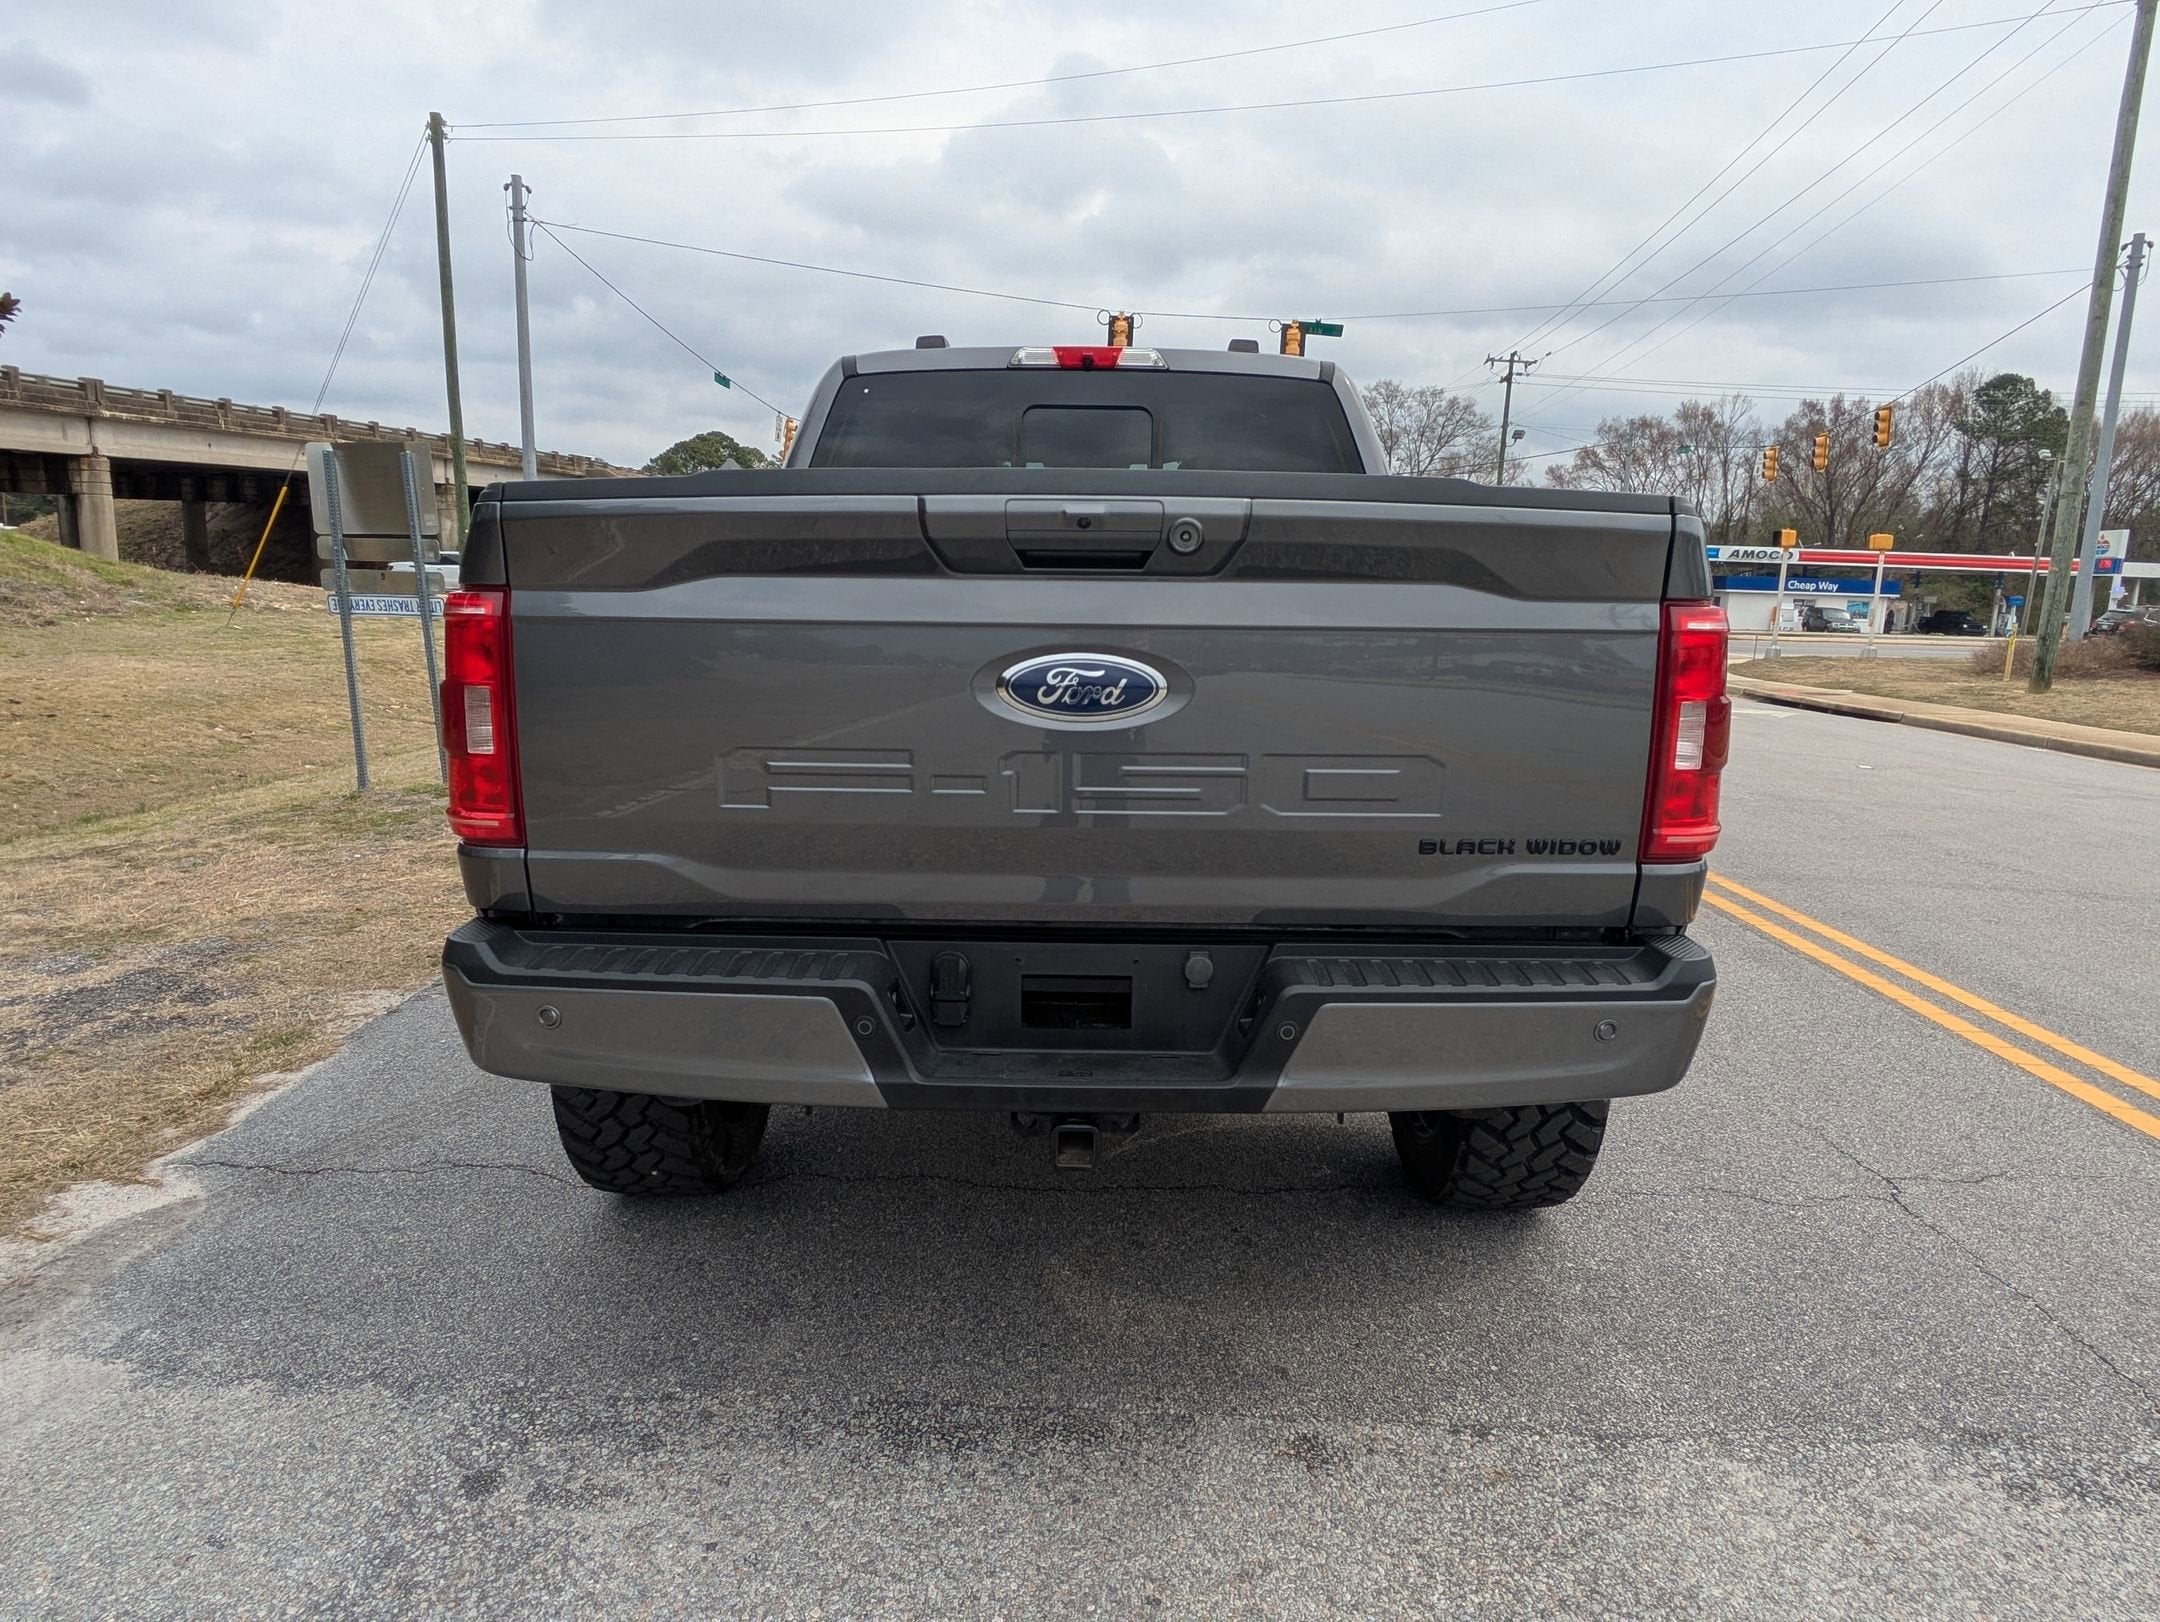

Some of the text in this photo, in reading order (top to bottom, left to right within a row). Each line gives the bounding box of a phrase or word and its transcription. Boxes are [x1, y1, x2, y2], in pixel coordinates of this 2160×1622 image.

[1729, 549, 1794, 560] AMOCO
[1788, 580, 1839, 593] Cheap Way
[332, 598, 442, 613] LITR TRASHES EVERYE
[1037, 667, 1127, 705] Ford
[714, 746, 1446, 818] F-150
[1418, 839, 1622, 856] BLACK WIDOW
